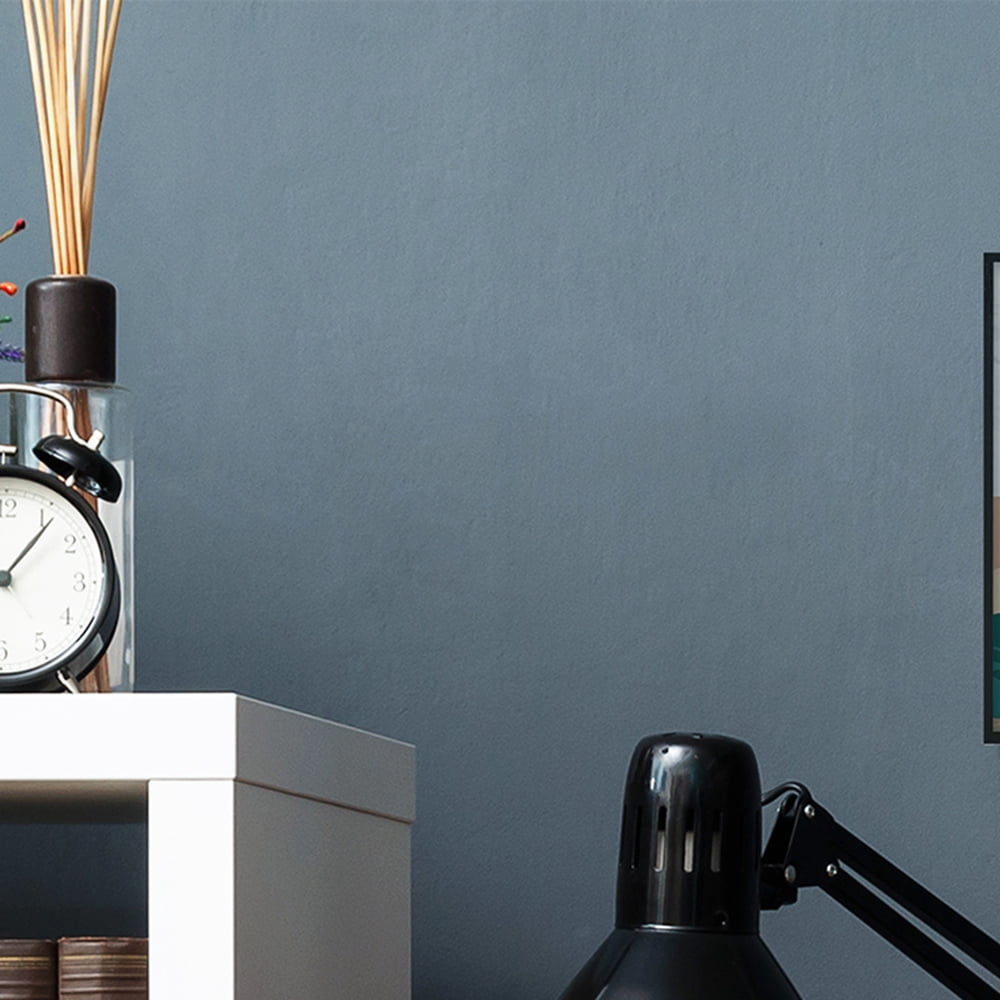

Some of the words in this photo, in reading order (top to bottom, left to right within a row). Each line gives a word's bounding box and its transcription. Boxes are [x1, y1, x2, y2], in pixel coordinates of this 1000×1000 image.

[64, 534, 77, 553] 2
[73, 571, 86, 592] 3
[60, 607, 73, 625] 4
[35, 632, 47, 652] 5
